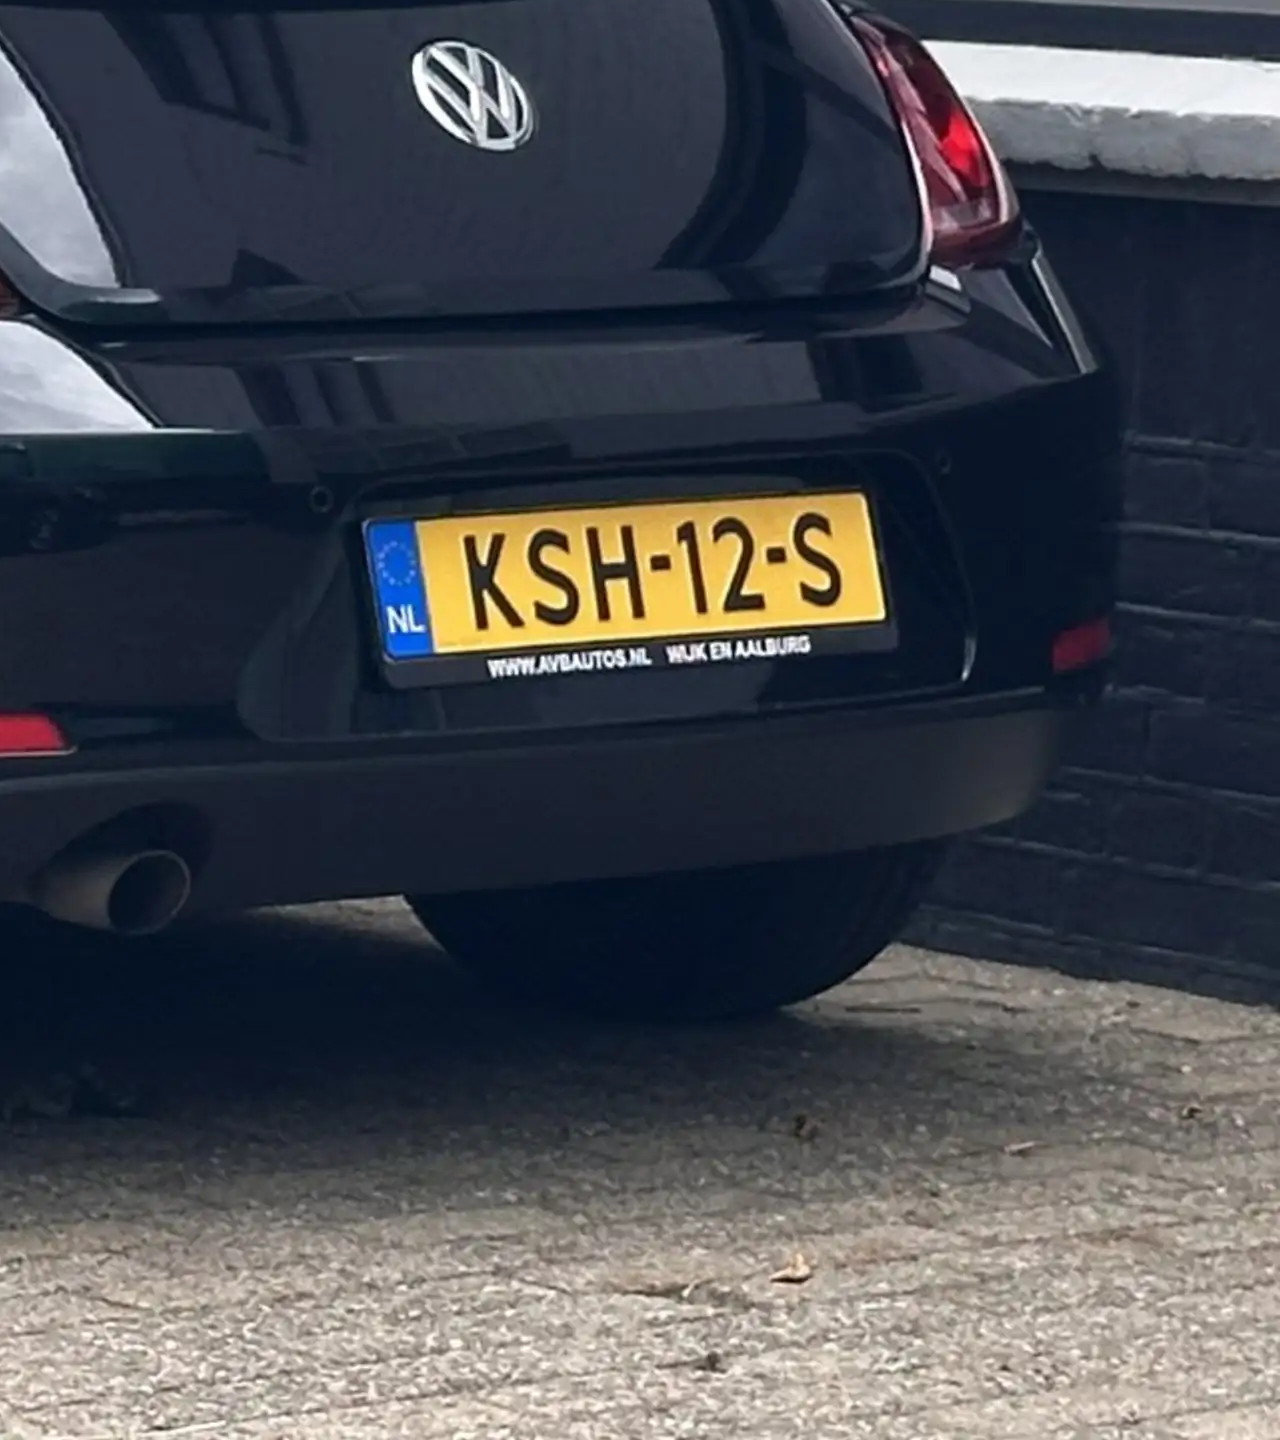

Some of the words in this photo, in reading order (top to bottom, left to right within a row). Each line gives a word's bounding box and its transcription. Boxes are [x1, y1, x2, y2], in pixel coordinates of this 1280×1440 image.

[462, 512, 843, 631] KSH-12-S
[385, 603, 427, 634] NL
[487, 647, 652, 679] WWW.AVBAUTOS.NL
[709, 640, 733, 660] EN
[733, 635, 812, 658] AALBURG
